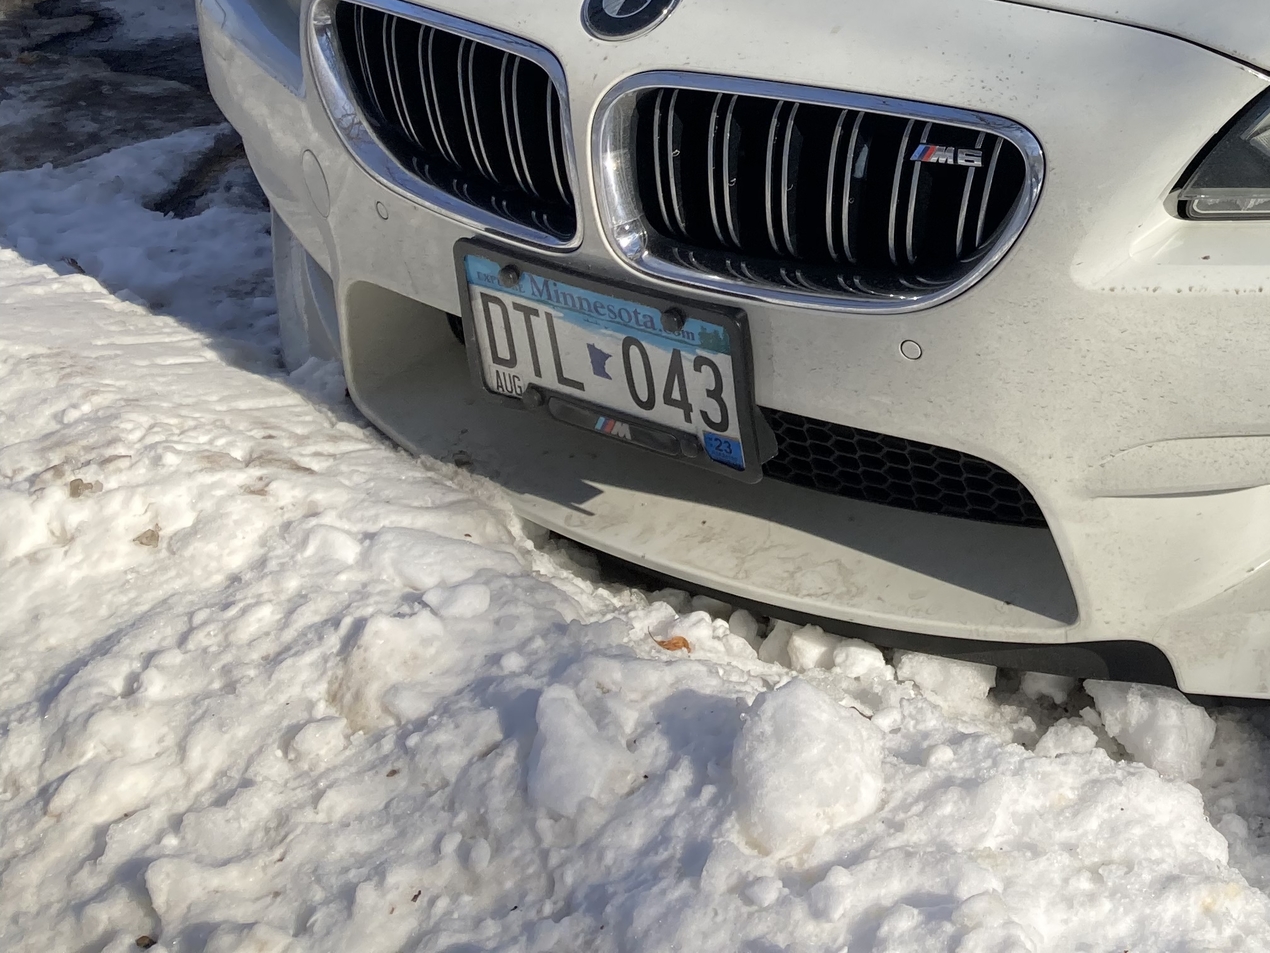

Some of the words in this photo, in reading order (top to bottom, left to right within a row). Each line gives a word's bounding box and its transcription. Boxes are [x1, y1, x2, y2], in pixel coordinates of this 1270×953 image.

[928, 145, 983, 166] M6
[477, 271, 526, 294] EXPLE
[480, 292, 585, 392] DTL
[622, 336, 729, 433] 043
[495, 370, 523, 397] AUG
[713, 437, 733, 455] 23
